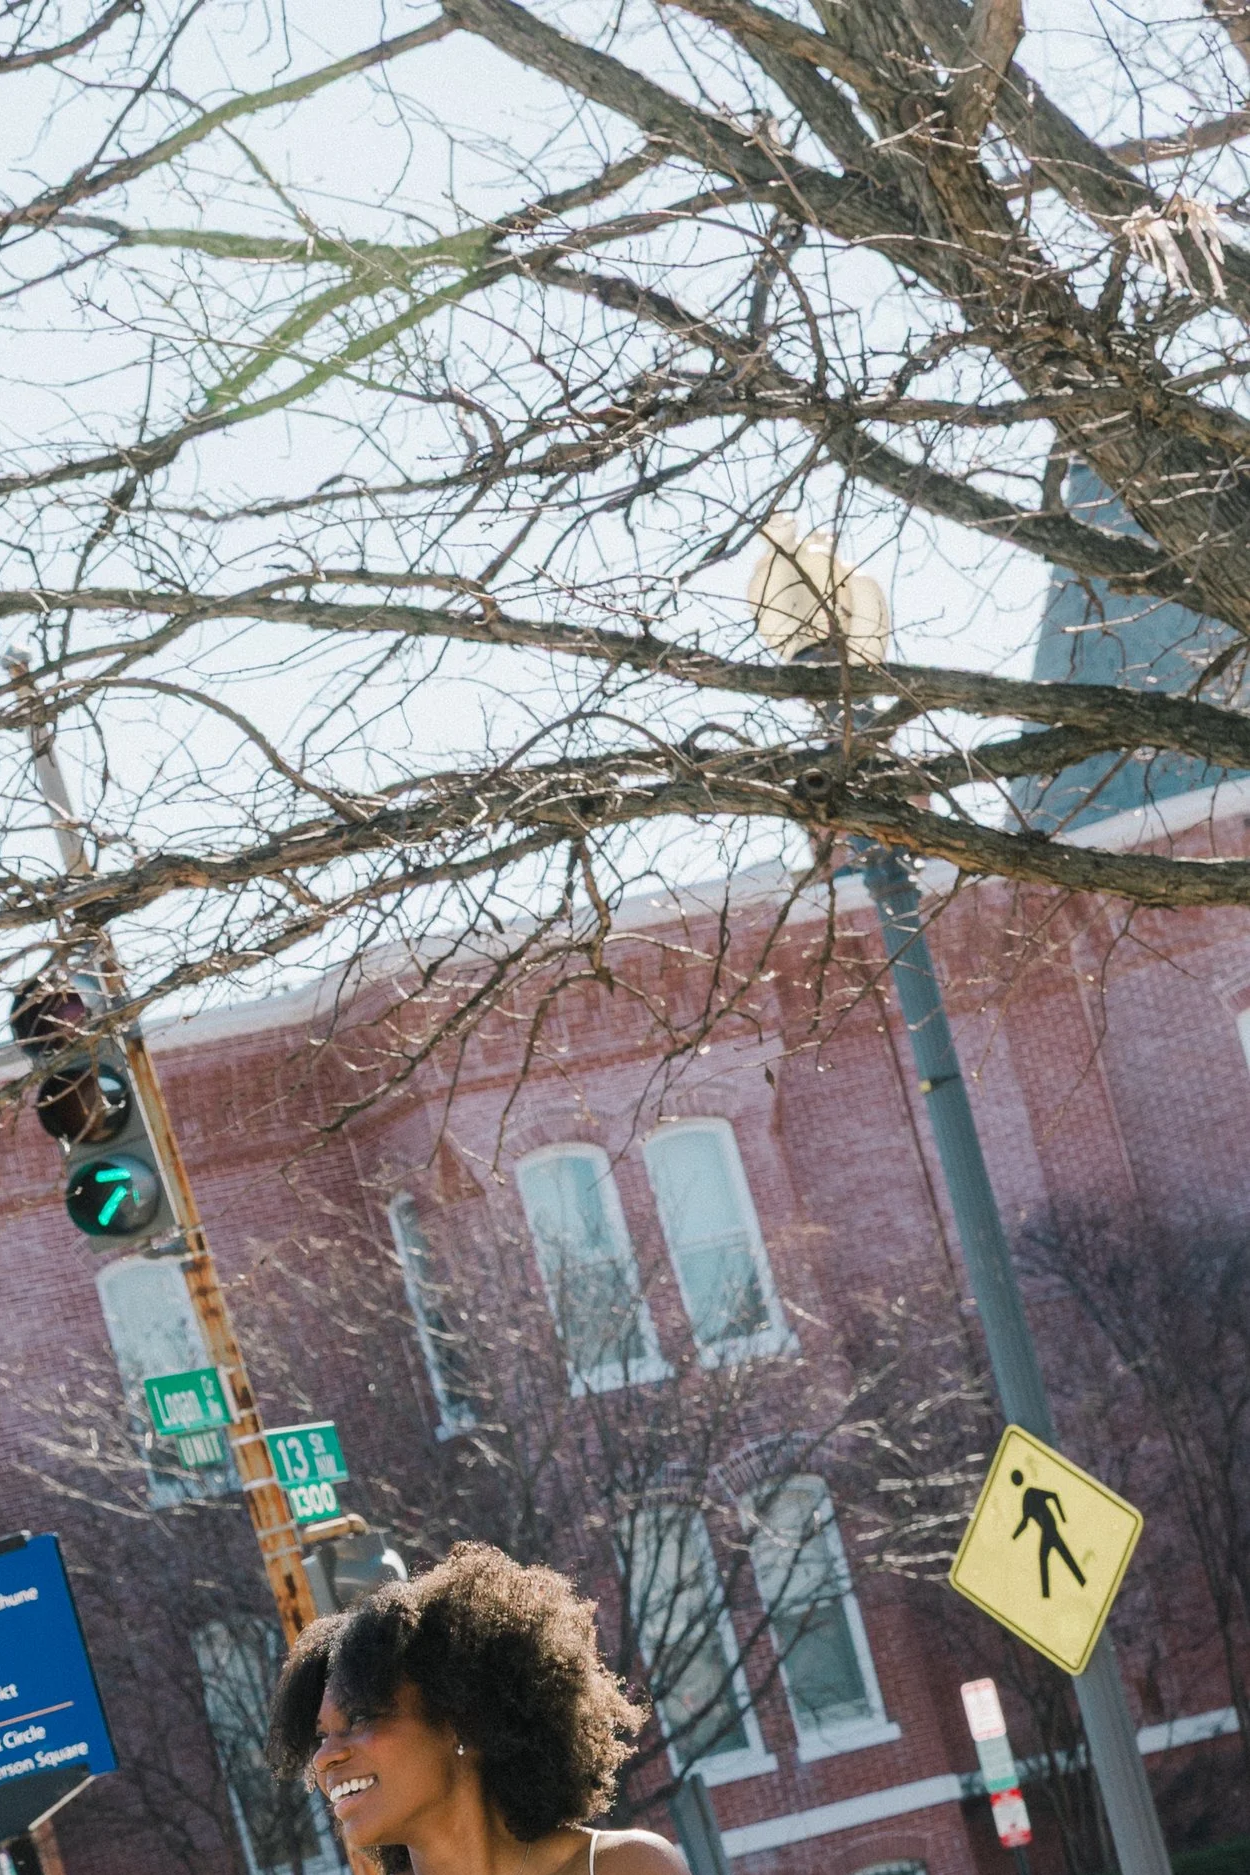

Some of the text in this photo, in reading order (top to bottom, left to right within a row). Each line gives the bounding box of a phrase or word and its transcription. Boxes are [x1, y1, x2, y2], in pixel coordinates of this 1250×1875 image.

[277, 1437, 309, 1481] 13
[289, 1482, 337, 1518] 1300
[3, 1726, 45, 1748] Circle
[35, 1742, 88, 1767] Square
